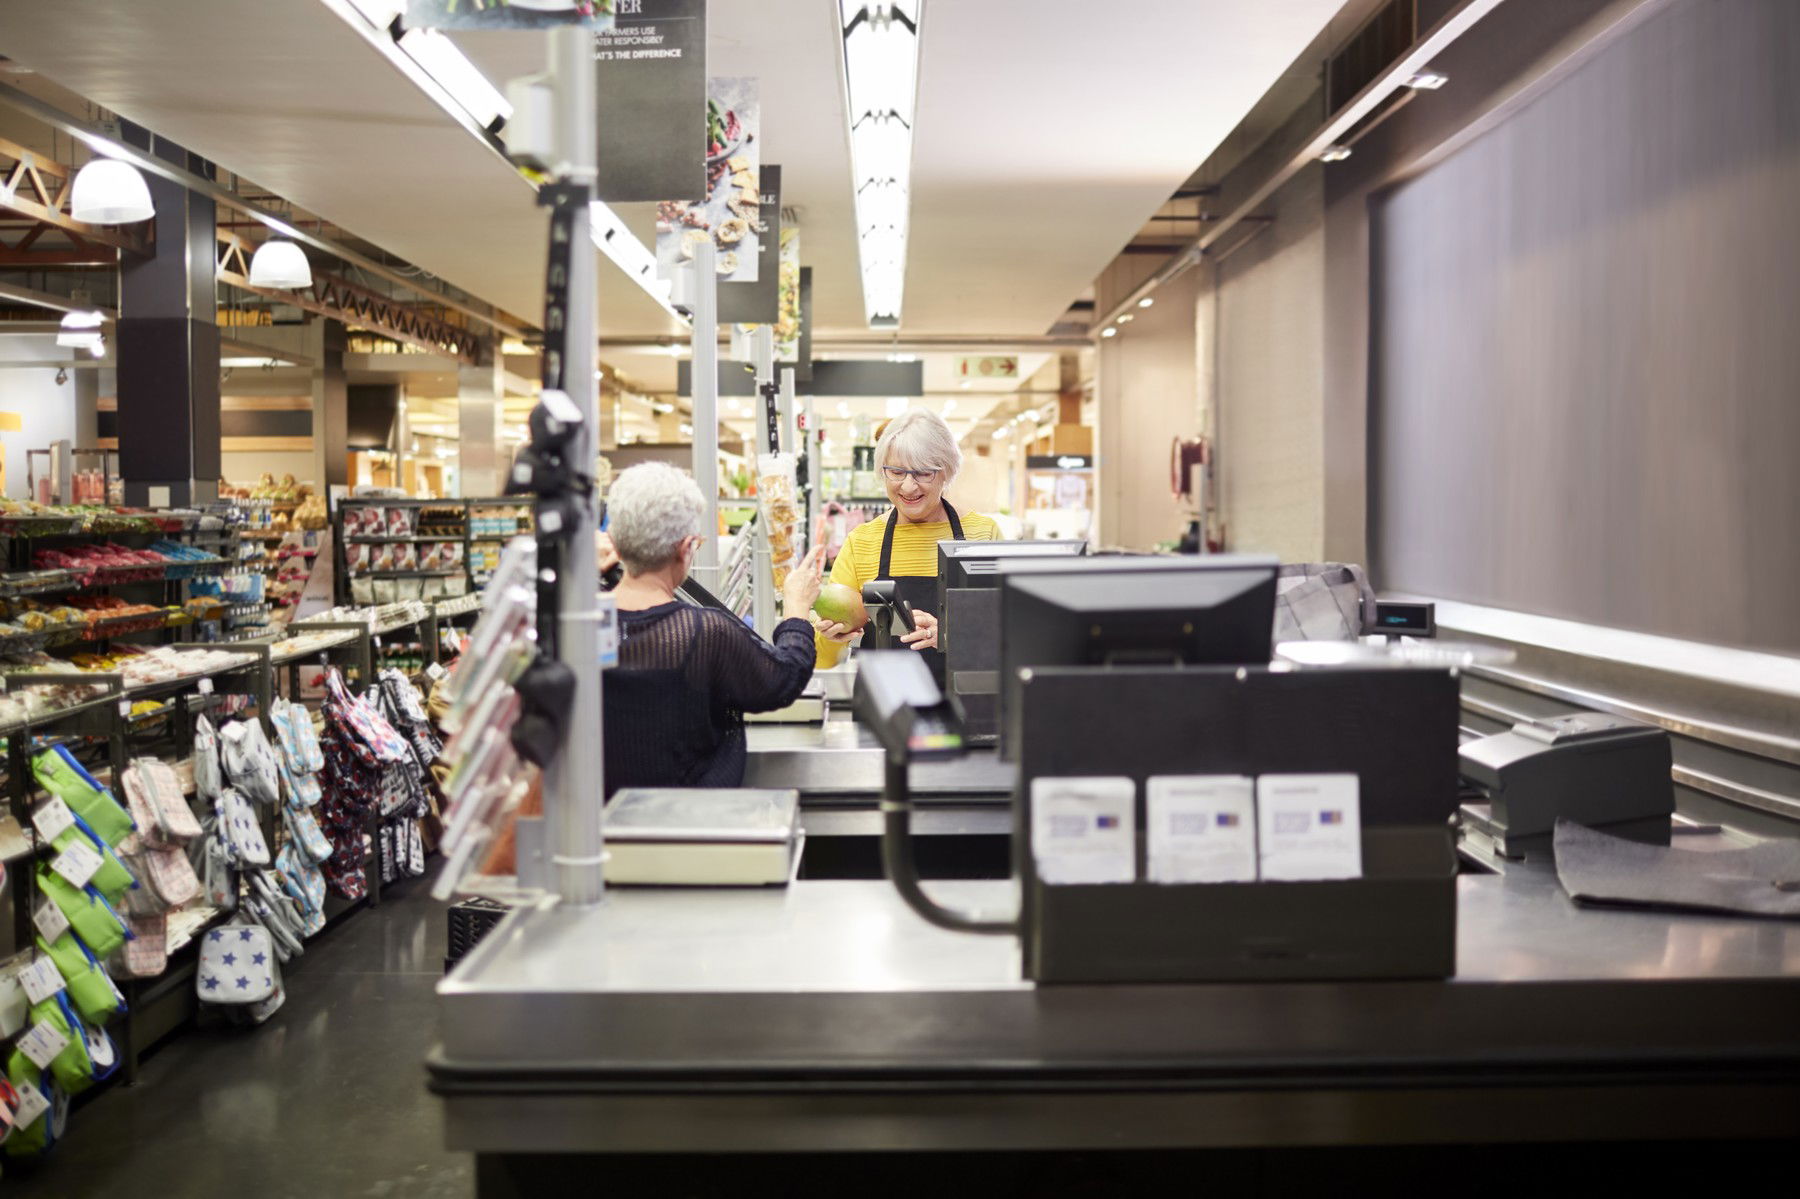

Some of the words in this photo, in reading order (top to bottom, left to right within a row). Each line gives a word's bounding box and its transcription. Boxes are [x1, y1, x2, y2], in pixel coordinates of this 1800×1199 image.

[641, 27, 656, 35] USE
[615, 50, 631, 59] THE
[632, 49, 681, 59] DIFFERENCE
